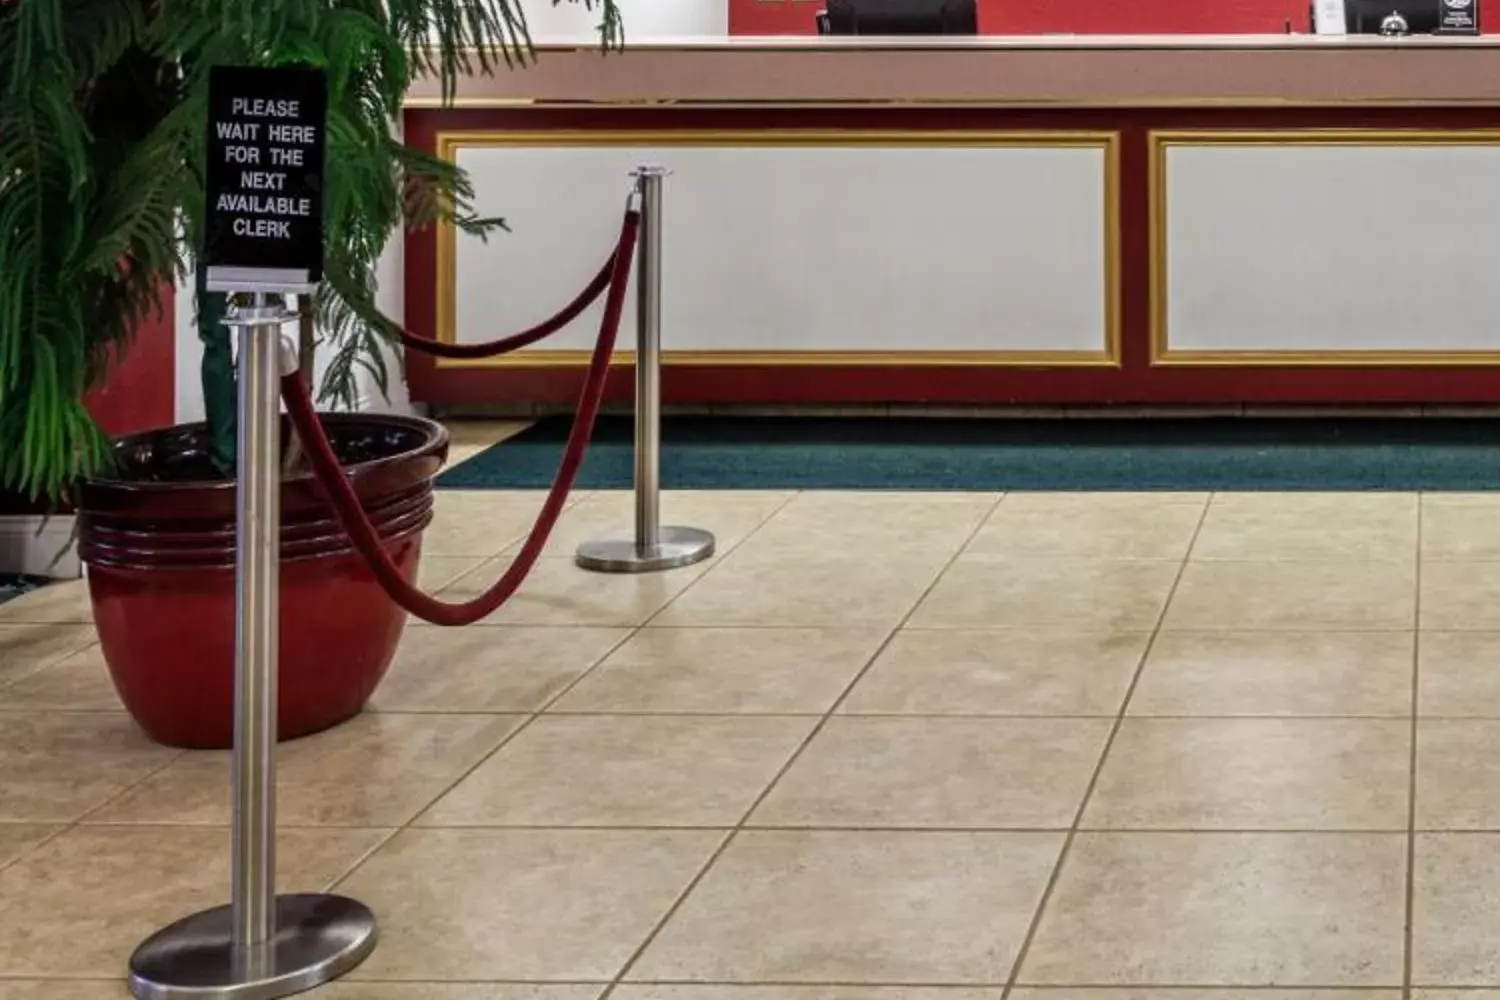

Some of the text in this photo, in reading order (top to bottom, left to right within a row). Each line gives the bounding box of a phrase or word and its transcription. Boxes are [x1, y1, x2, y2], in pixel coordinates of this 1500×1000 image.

[232, 98, 300, 118] PLEASE
[216, 122, 316, 144] WAIT HERE
[225, 146, 304, 166] FOR THE
[241, 172, 287, 191] NEXT
[216, 193, 311, 216] AVAILABLE
[233, 218, 292, 240] CLERK
